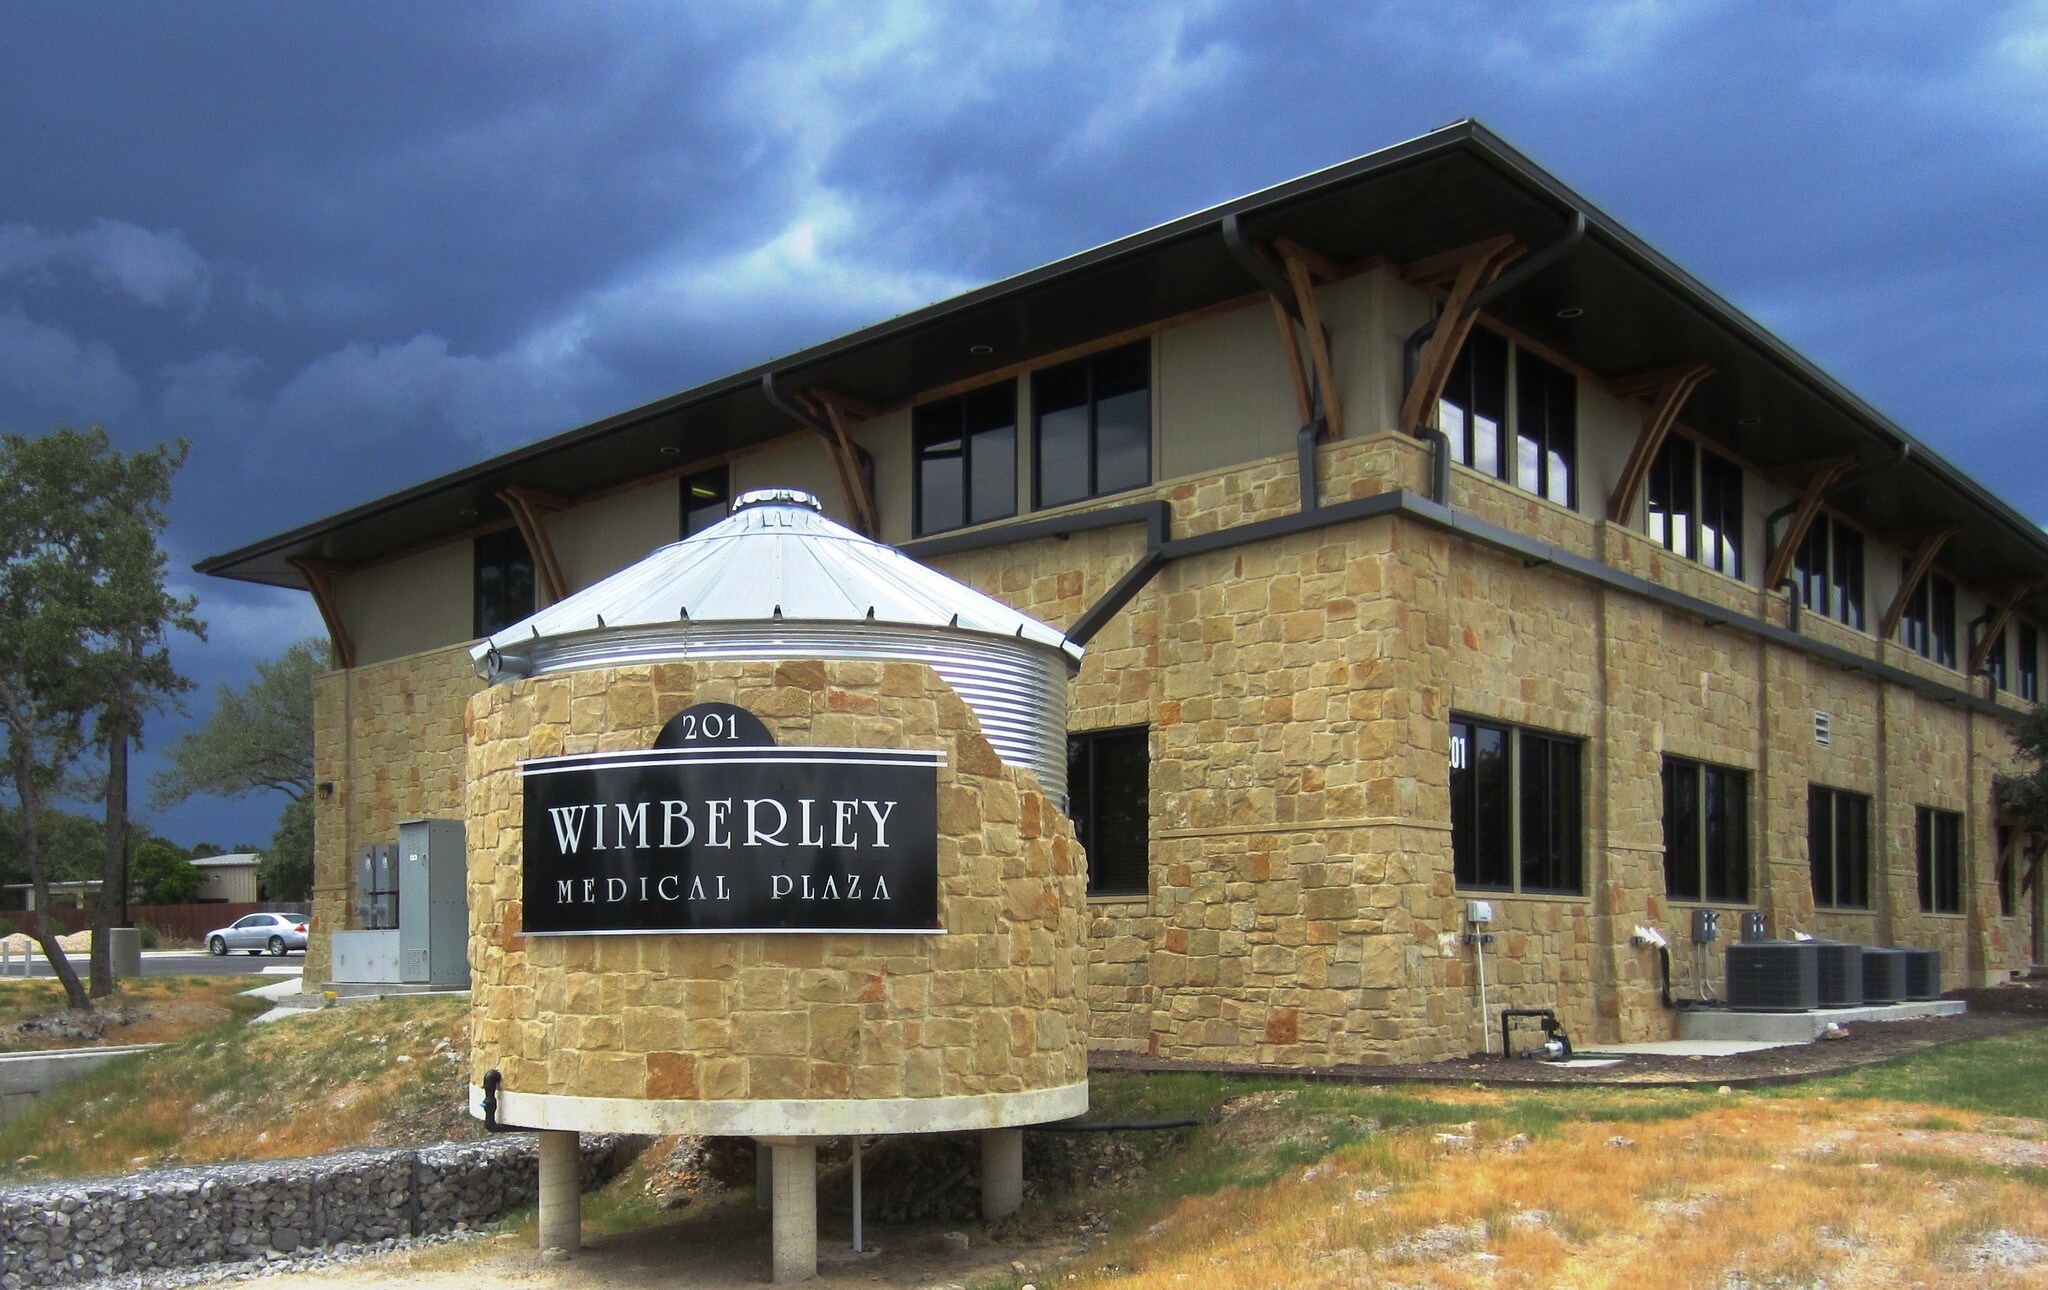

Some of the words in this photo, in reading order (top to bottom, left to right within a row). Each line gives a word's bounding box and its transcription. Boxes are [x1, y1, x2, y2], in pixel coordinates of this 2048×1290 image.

[682, 713, 739, 740] 201
[1449, 736, 1466, 769] 01
[548, 797, 898, 855] WIMBERLEY
[557, 875, 730, 904] MEDICAL
[771, 874, 891, 900] PLAZA
